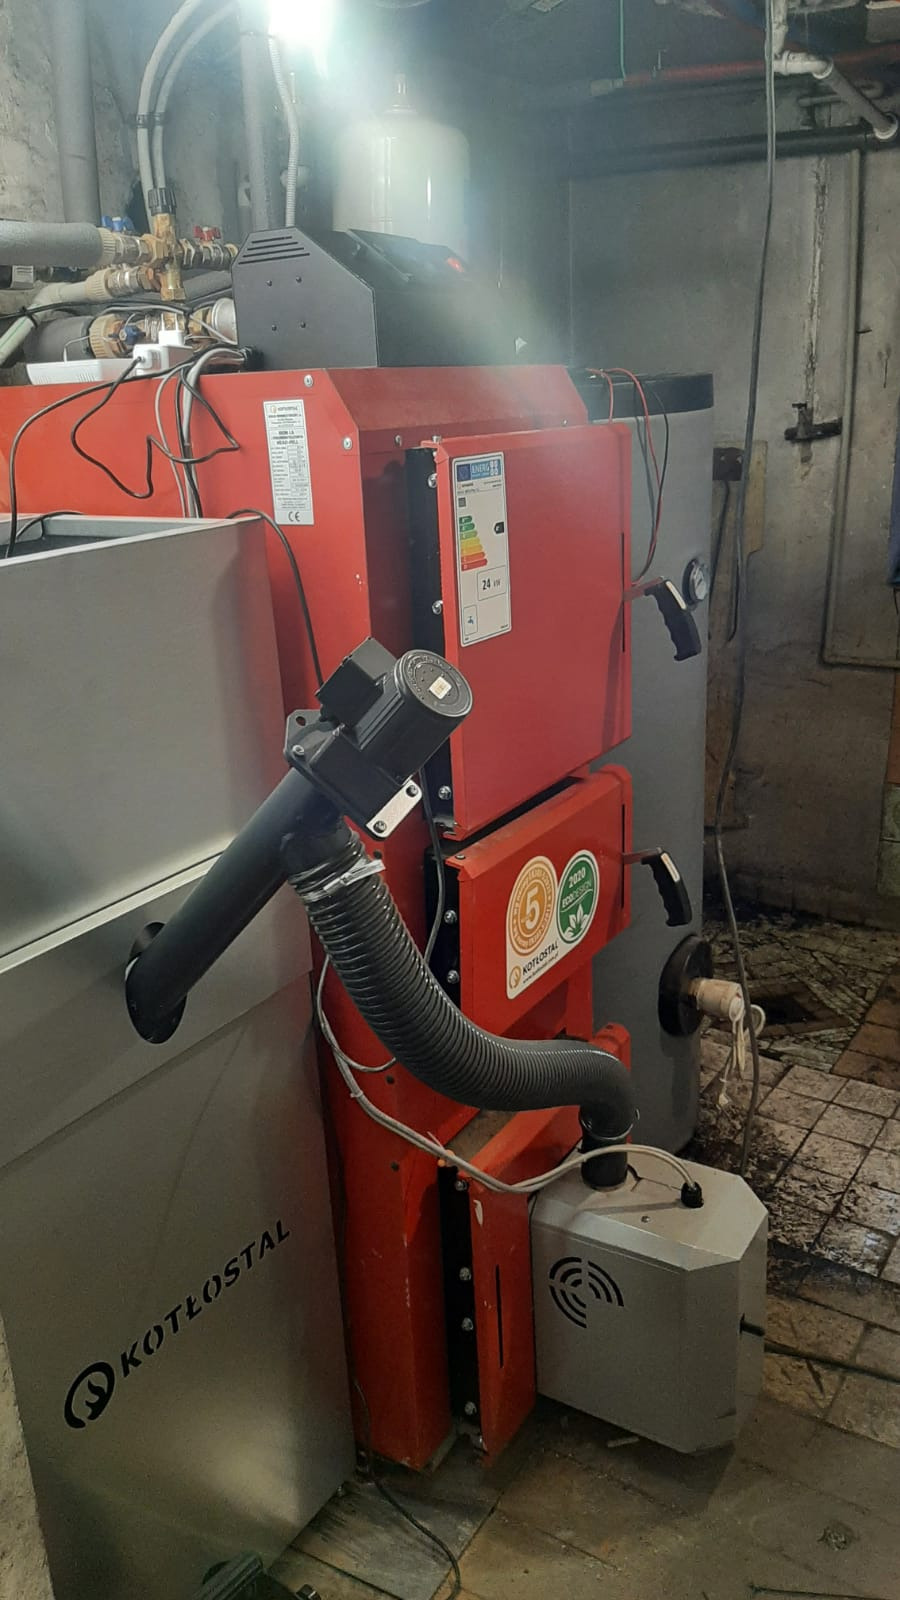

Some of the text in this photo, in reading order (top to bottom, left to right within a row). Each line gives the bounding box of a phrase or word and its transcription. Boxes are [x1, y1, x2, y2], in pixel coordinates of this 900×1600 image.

[482, 578, 491, 590] 24
[568, 867, 586, 888] 2020
[525, 887, 540, 930] 5
[522, 940, 559, 976] KOTŁOSTAL
[120, 1219, 291, 1378] KOTŁOSTAL
